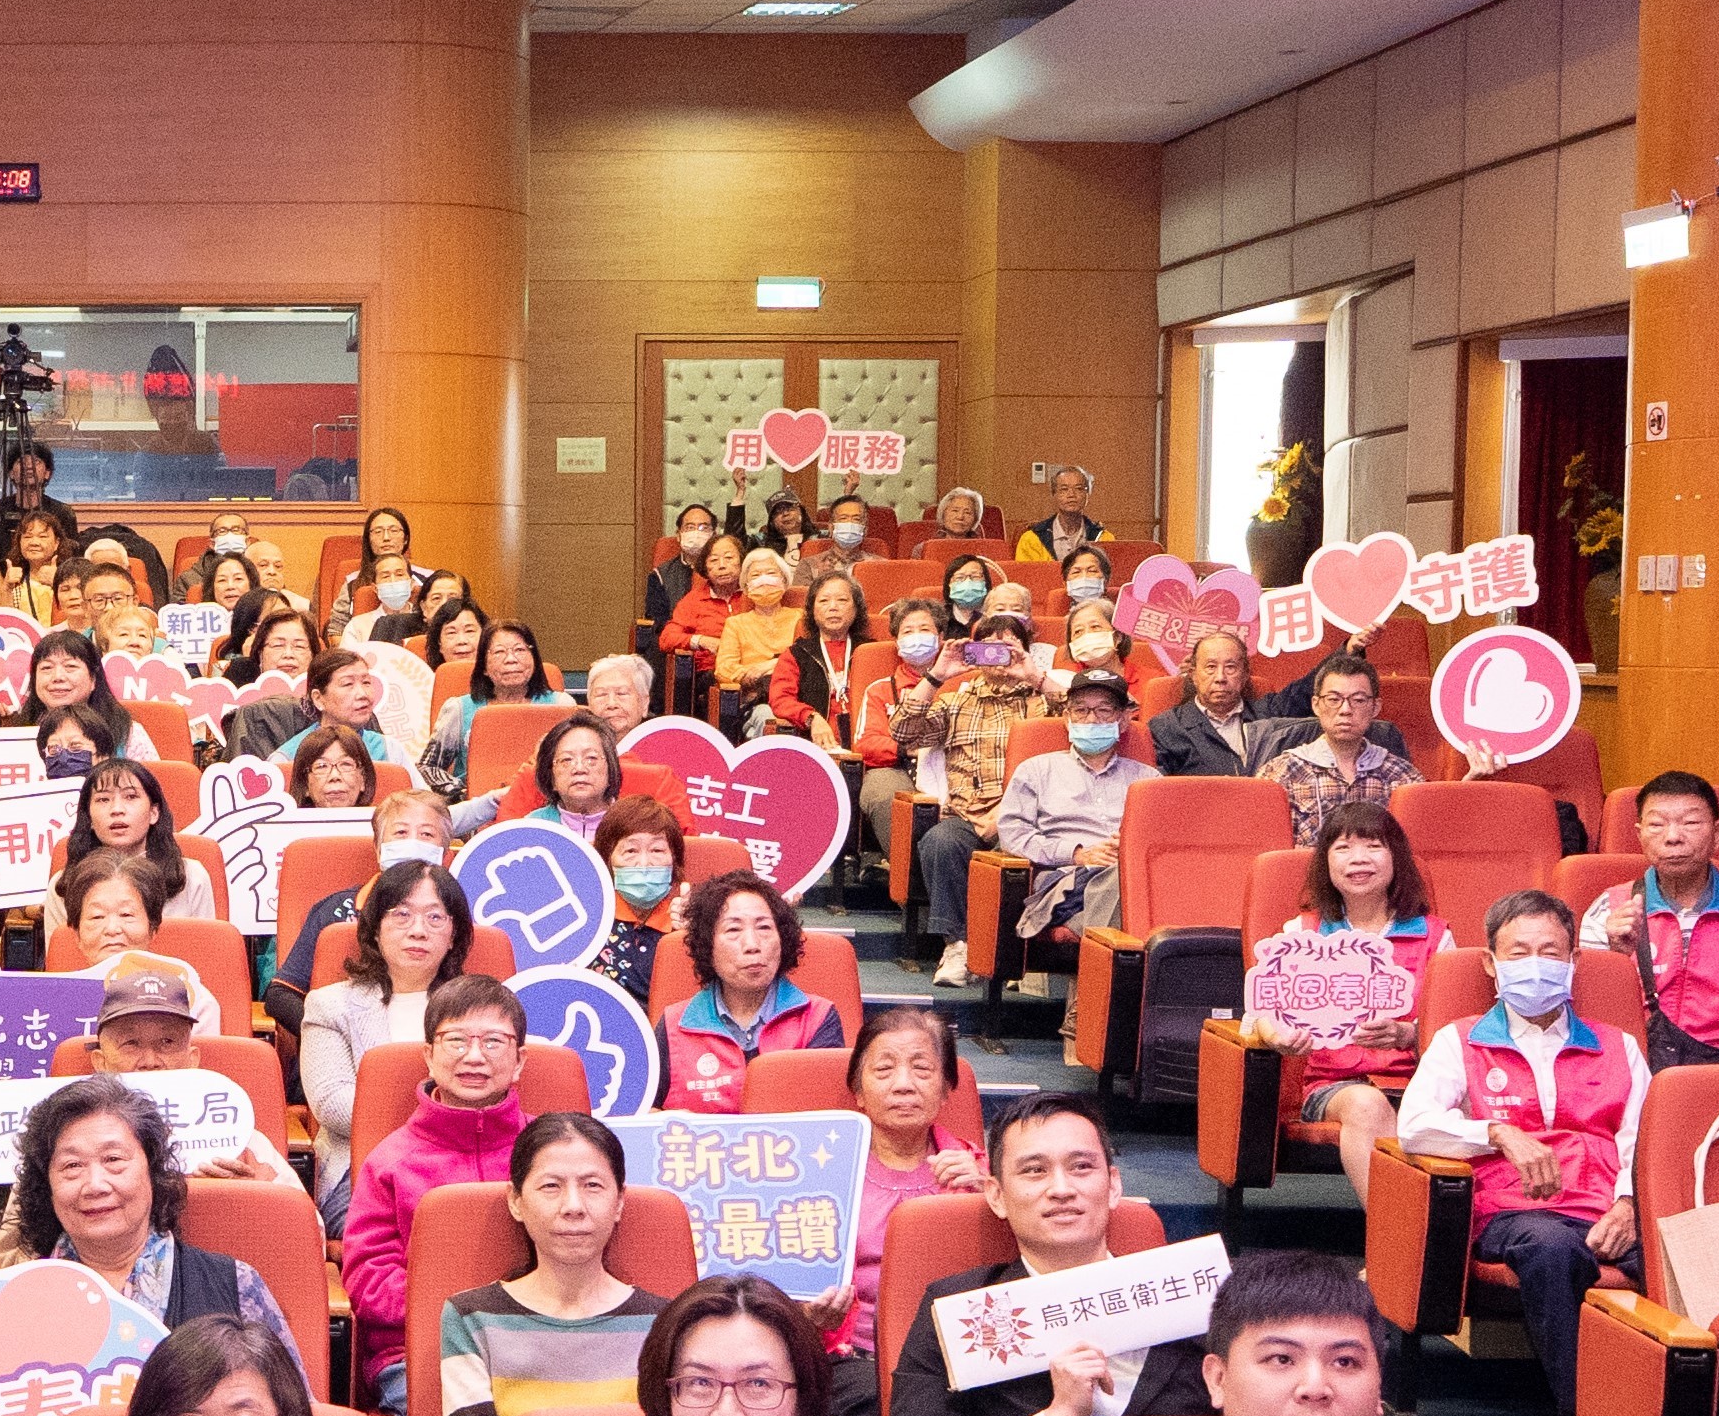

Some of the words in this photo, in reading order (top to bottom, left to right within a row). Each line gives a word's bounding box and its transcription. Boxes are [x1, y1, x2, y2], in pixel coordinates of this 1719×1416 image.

[728, 433, 761, 470] 用
[822, 432, 904, 471] 服務
[1265, 590, 1316, 650] 用
[1409, 540, 1531, 618] 守護
[166, 610, 222, 635] 新北
[686, 774, 770, 826] 志工
[1252, 973, 1409, 1013] 感恩奉獻
[660, 1123, 798, 1188] 新北
[1041, 1266, 1221, 1331] 烏來區衛生所
